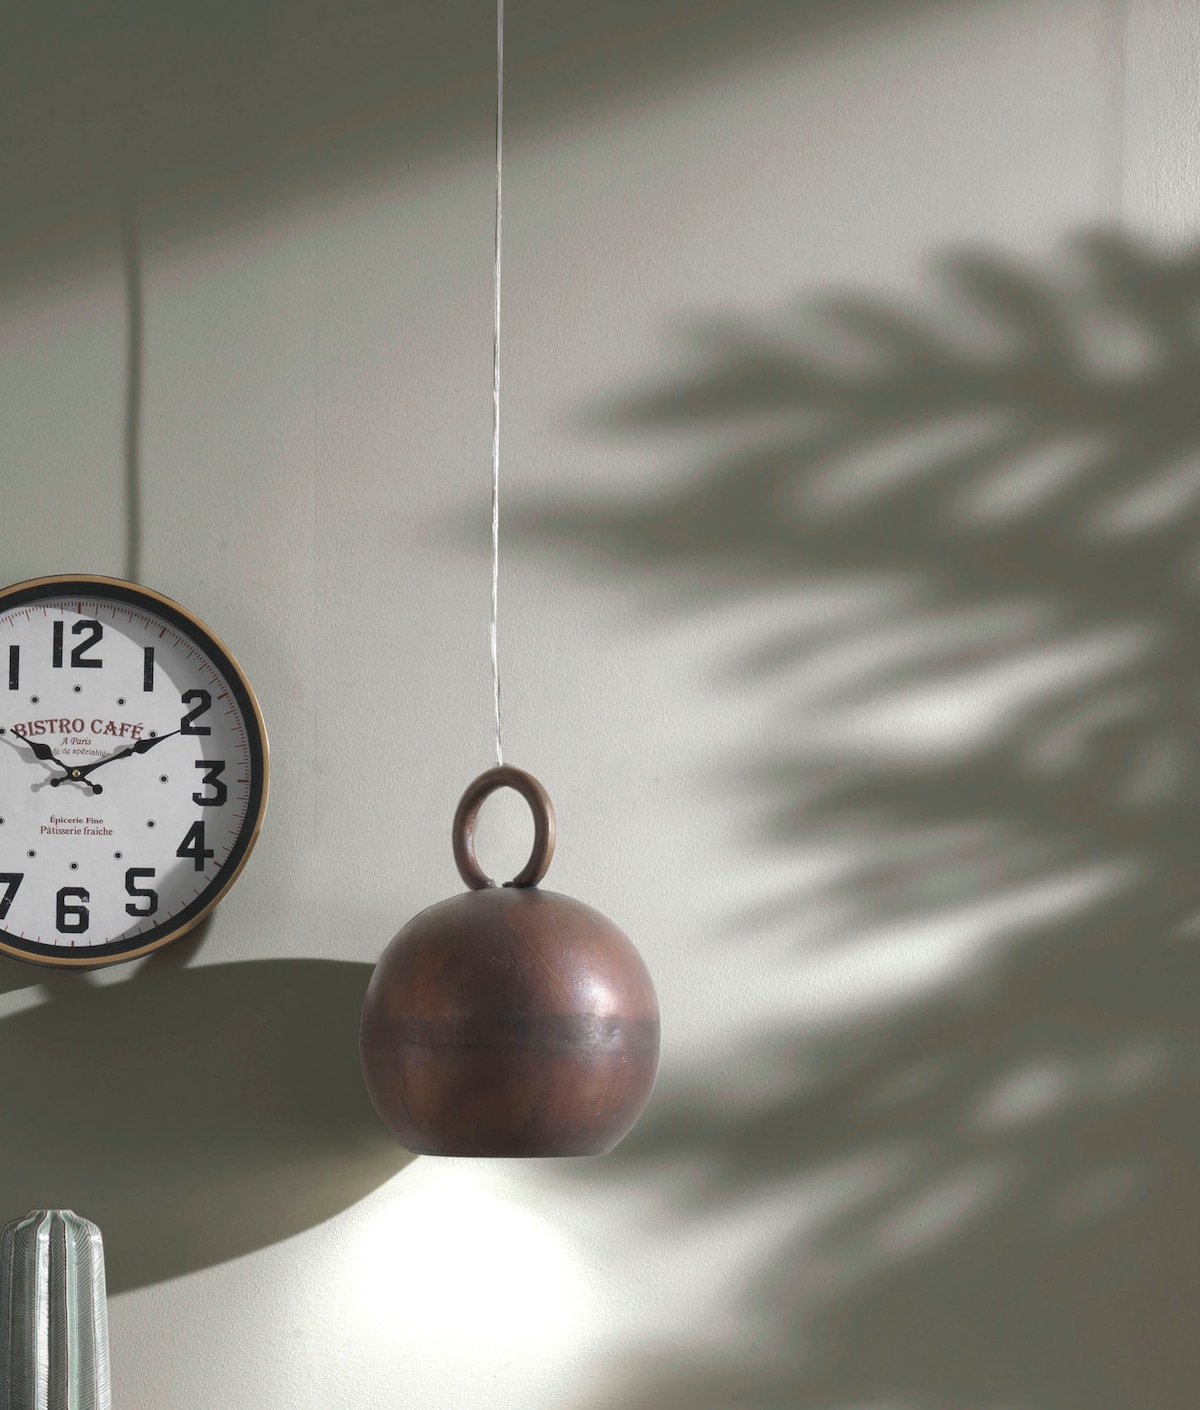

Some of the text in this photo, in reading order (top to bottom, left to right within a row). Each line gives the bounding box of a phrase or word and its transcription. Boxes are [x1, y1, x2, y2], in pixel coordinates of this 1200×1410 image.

[52, 619, 103, 669] 12
[143, 646, 155, 692] 1
[13, 718, 145, 741] BISTRO CAFÉ
[180, 688, 212, 736] 2
[191, 760, 228, 807] 3
[40, 826, 82, 836] Pâtisserie
[86, 816, 104, 825] Fine
[175, 820, 214, 872] 4
[55, 886, 90, 934] 6
[124, 867, 159, 917] 5
